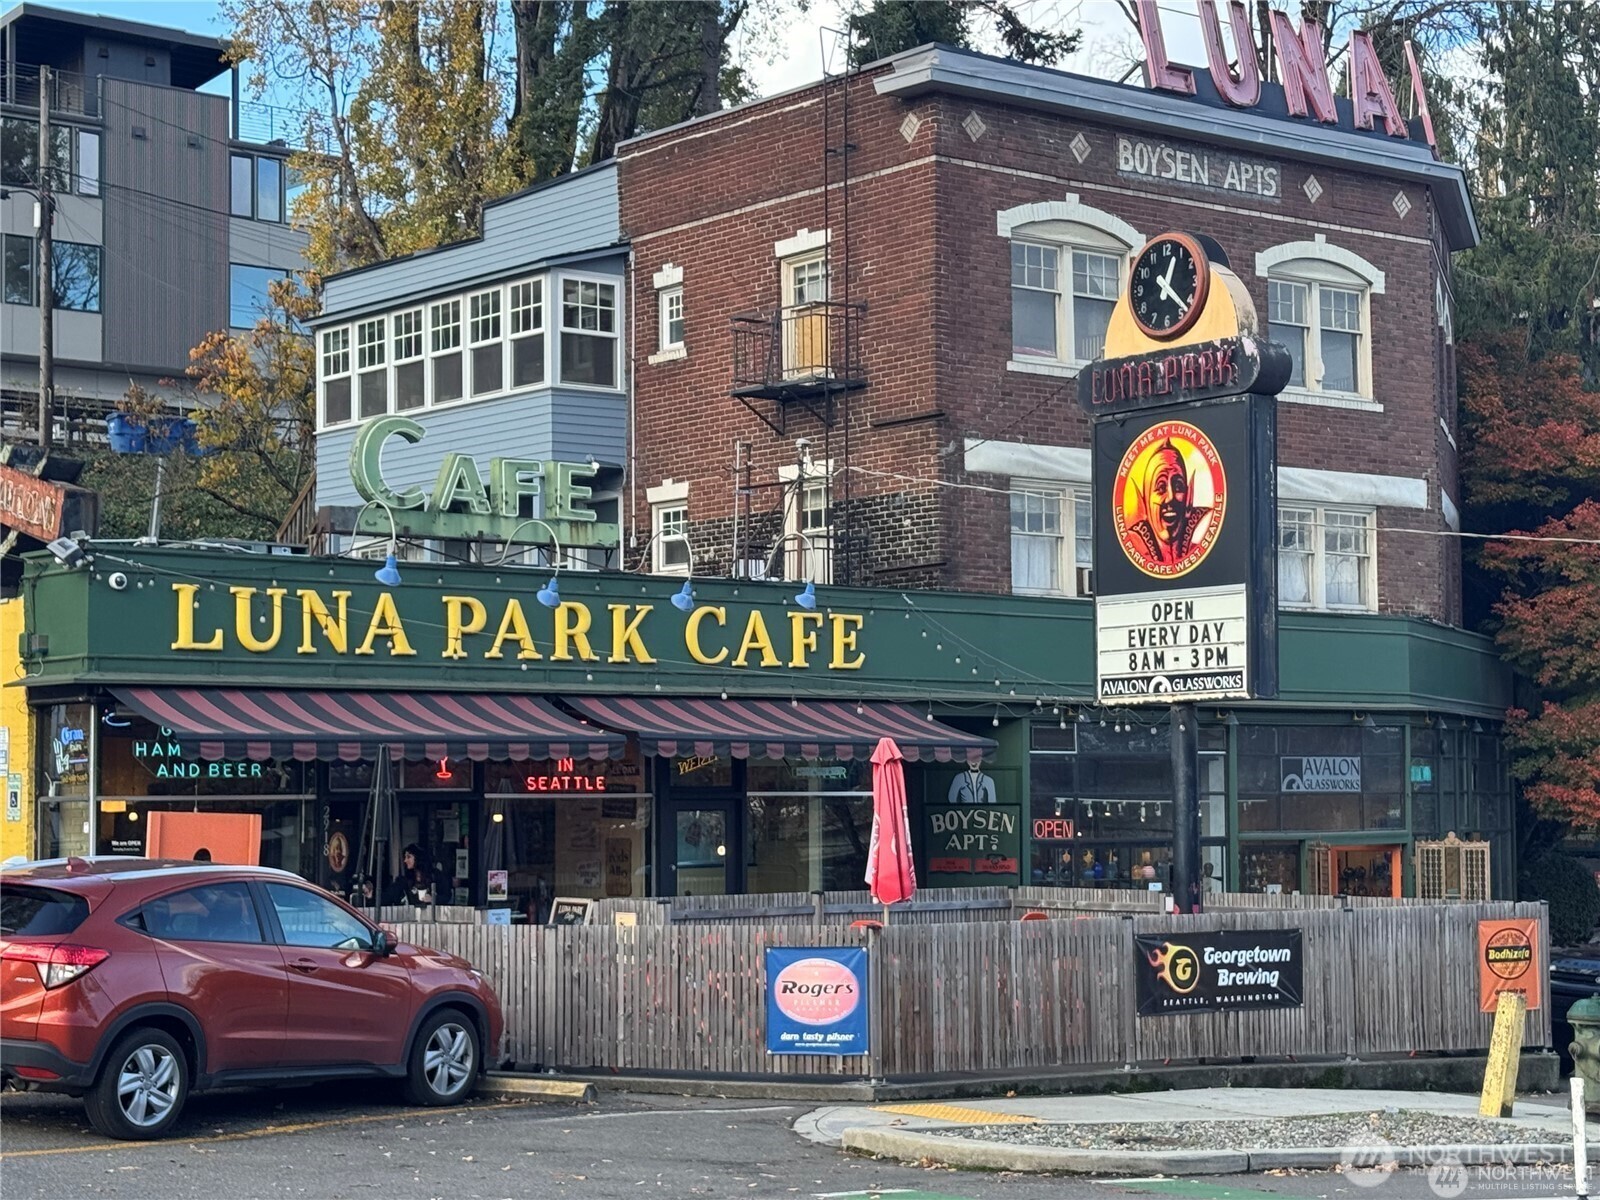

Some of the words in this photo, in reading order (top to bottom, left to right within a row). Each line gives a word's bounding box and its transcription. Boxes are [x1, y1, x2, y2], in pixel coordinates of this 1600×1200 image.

[1139, 0, 1407, 138] LUNA
[1223, 160, 1278, 197] APTS
[1161, 348, 1233, 394] PARK
[1120, 447, 1140, 478] MEET
[1140, 432, 1155, 446] ME
[1156, 426, 1170, 437] AT
[1171, 426, 1198, 441] LUNA
[1198, 438, 1218, 466] PARK
[350, 415, 598, 522] CAFE
[1116, 504, 1127, 540] LUNA
[1125, 541, 1146, 566] PARK
[1146, 561, 1172, 574] CAFE
[1175, 550, 1202, 572] WEST
[1202, 493, 1224, 550] SEATTLE
[1152, 600, 1194, 622] OPEN
[171, 583, 417, 655] LUNA
[442, 595, 657, 664] PARK
[685, 605, 866, 670] CAFE
[1128, 626, 1180, 648] EVERY
[1190, 622, 1224, 644] DAY
[1129, 650, 1165, 671] 8AM
[1191, 646, 1228, 668] 3PM
[1102, 680, 1147, 695] AVALON
[1172, 674, 1242, 692] GLASSWORKS
[156, 763, 200, 778] AND
[208, 763, 262, 778] BEER
[558, 758, 574, 772] IN
[1304, 758, 1360, 776] AVALON
[527, 776, 606, 790] SEATTLE
[1304, 779, 1360, 790] GLASSWORKS
[930, 810, 1014, 834] BOYSEN
[1034, 820, 1073, 838] OPEN
[1204, 946, 1290, 966] Georgetown
[1488, 948, 1530, 960] Bodhizafa
[1217, 968, 1280, 988] Brewing
[1216, 993, 1280, 1003] WASHINGTON
[780, 1032, 800, 1040] darn
[803, 1032, 824, 1042] tasty
[826, 1032, 855, 1042] pilsner
